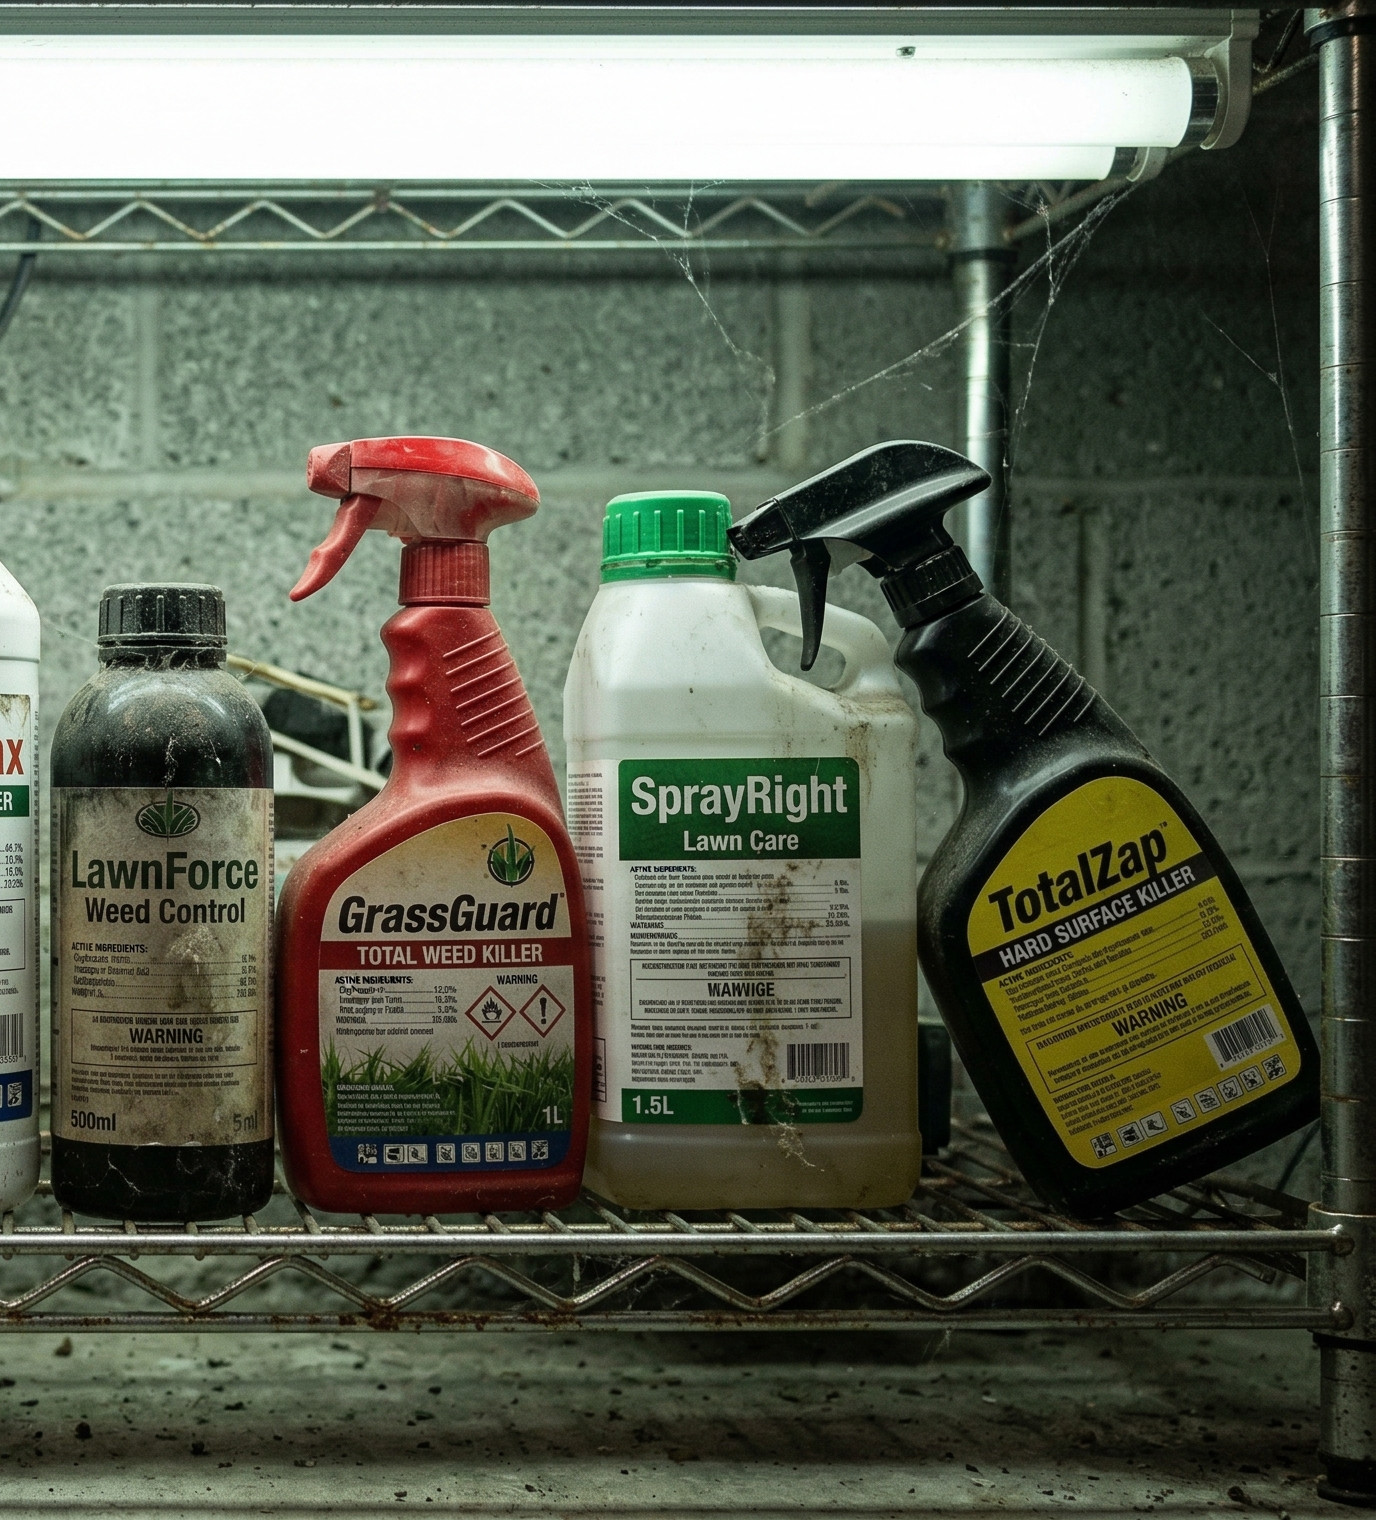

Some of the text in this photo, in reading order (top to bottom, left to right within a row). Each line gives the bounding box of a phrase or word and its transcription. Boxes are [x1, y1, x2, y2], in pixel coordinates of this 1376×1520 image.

[631, 774, 848, 823] SprayRight
[683, 829, 799, 852] Lawn Care
[72, 850, 258, 890] LawnForce
[987, 829, 1167, 934] TotalZap
[85, 896, 245, 924] Weed Control
[338, 892, 559, 934] GrassGuard
[998, 864, 1197, 970] HARD SURFACE KILLER
[357, 943, 543, 966] TOTAL WEED KILLER
[496, 974, 539, 985] WARNING
[1111, 991, 1189, 1037] WARNING
[129, 1028, 204, 1044] WARNING
[542, 1105, 563, 1125] 1L
[631, 1095, 675, 1115] 1.5L
[70, 1110, 117, 1132] 500ml
